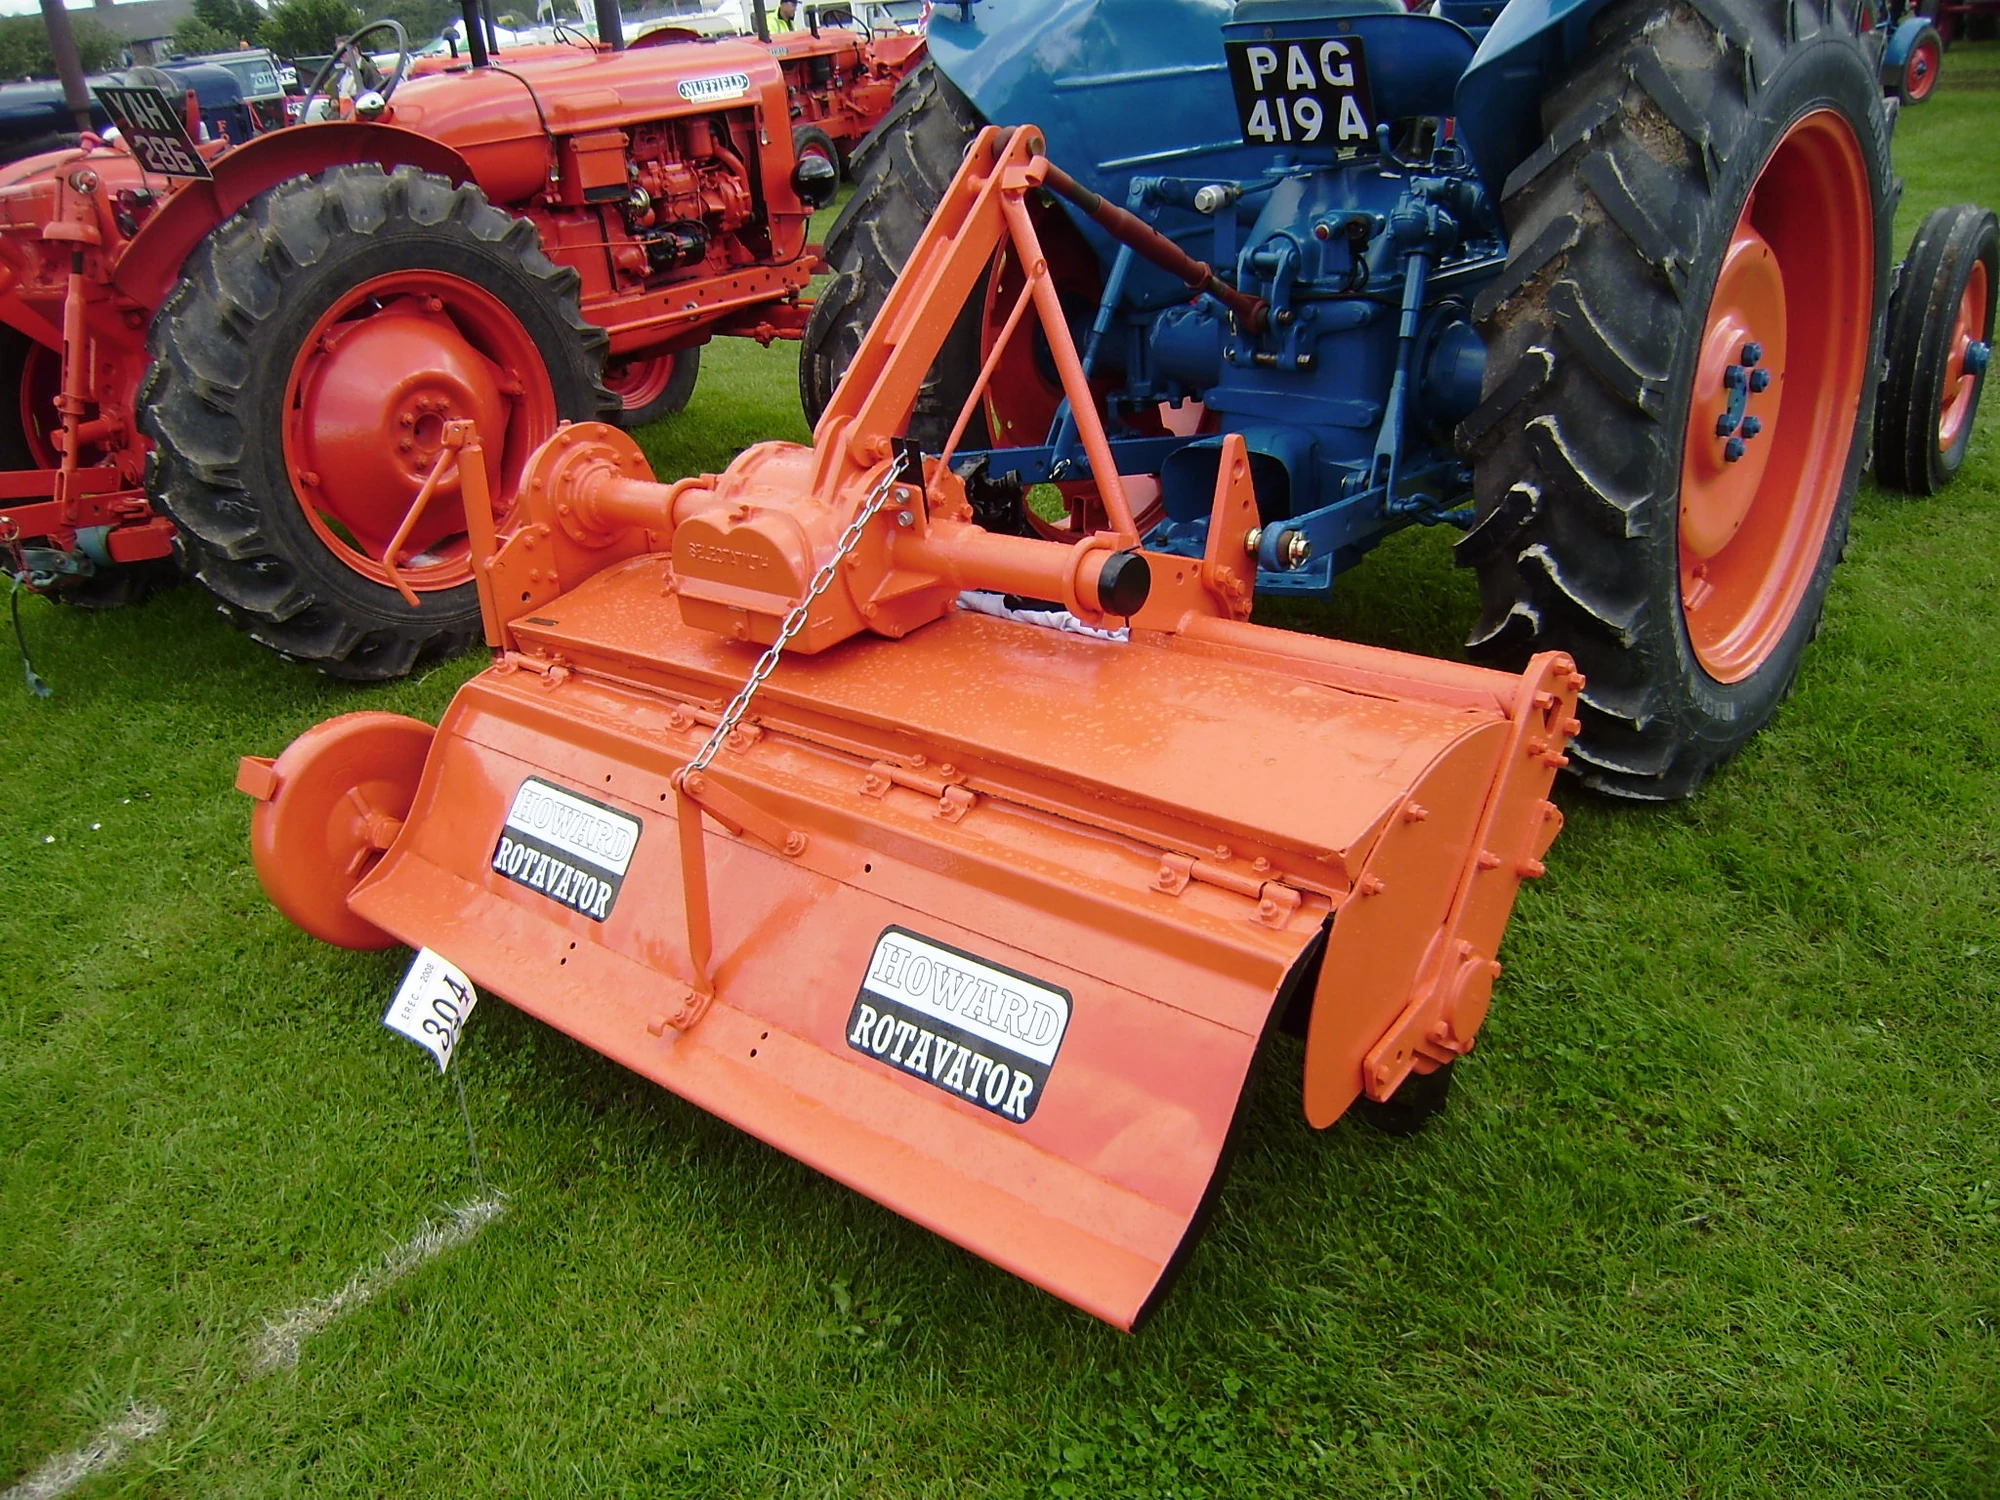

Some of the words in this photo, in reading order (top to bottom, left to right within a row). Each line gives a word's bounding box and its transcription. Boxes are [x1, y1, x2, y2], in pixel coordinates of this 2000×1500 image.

[682, 75, 744, 97] NUFFIELD
[1246, 40, 1355, 92] PAG
[105, 91, 171, 130] YAH
[1247, 97, 1323, 142] 419
[1338, 95, 1369, 140] A
[133, 135, 197, 173] 286
[512, 788, 632, 863] HOWARD
[493, 836, 613, 919] ROTAVATOR
[422, 974, 471, 1052] 304
[872, 941, 1060, 1047] HOWARD
[849, 1003, 1034, 1120] ROTAVATOR
